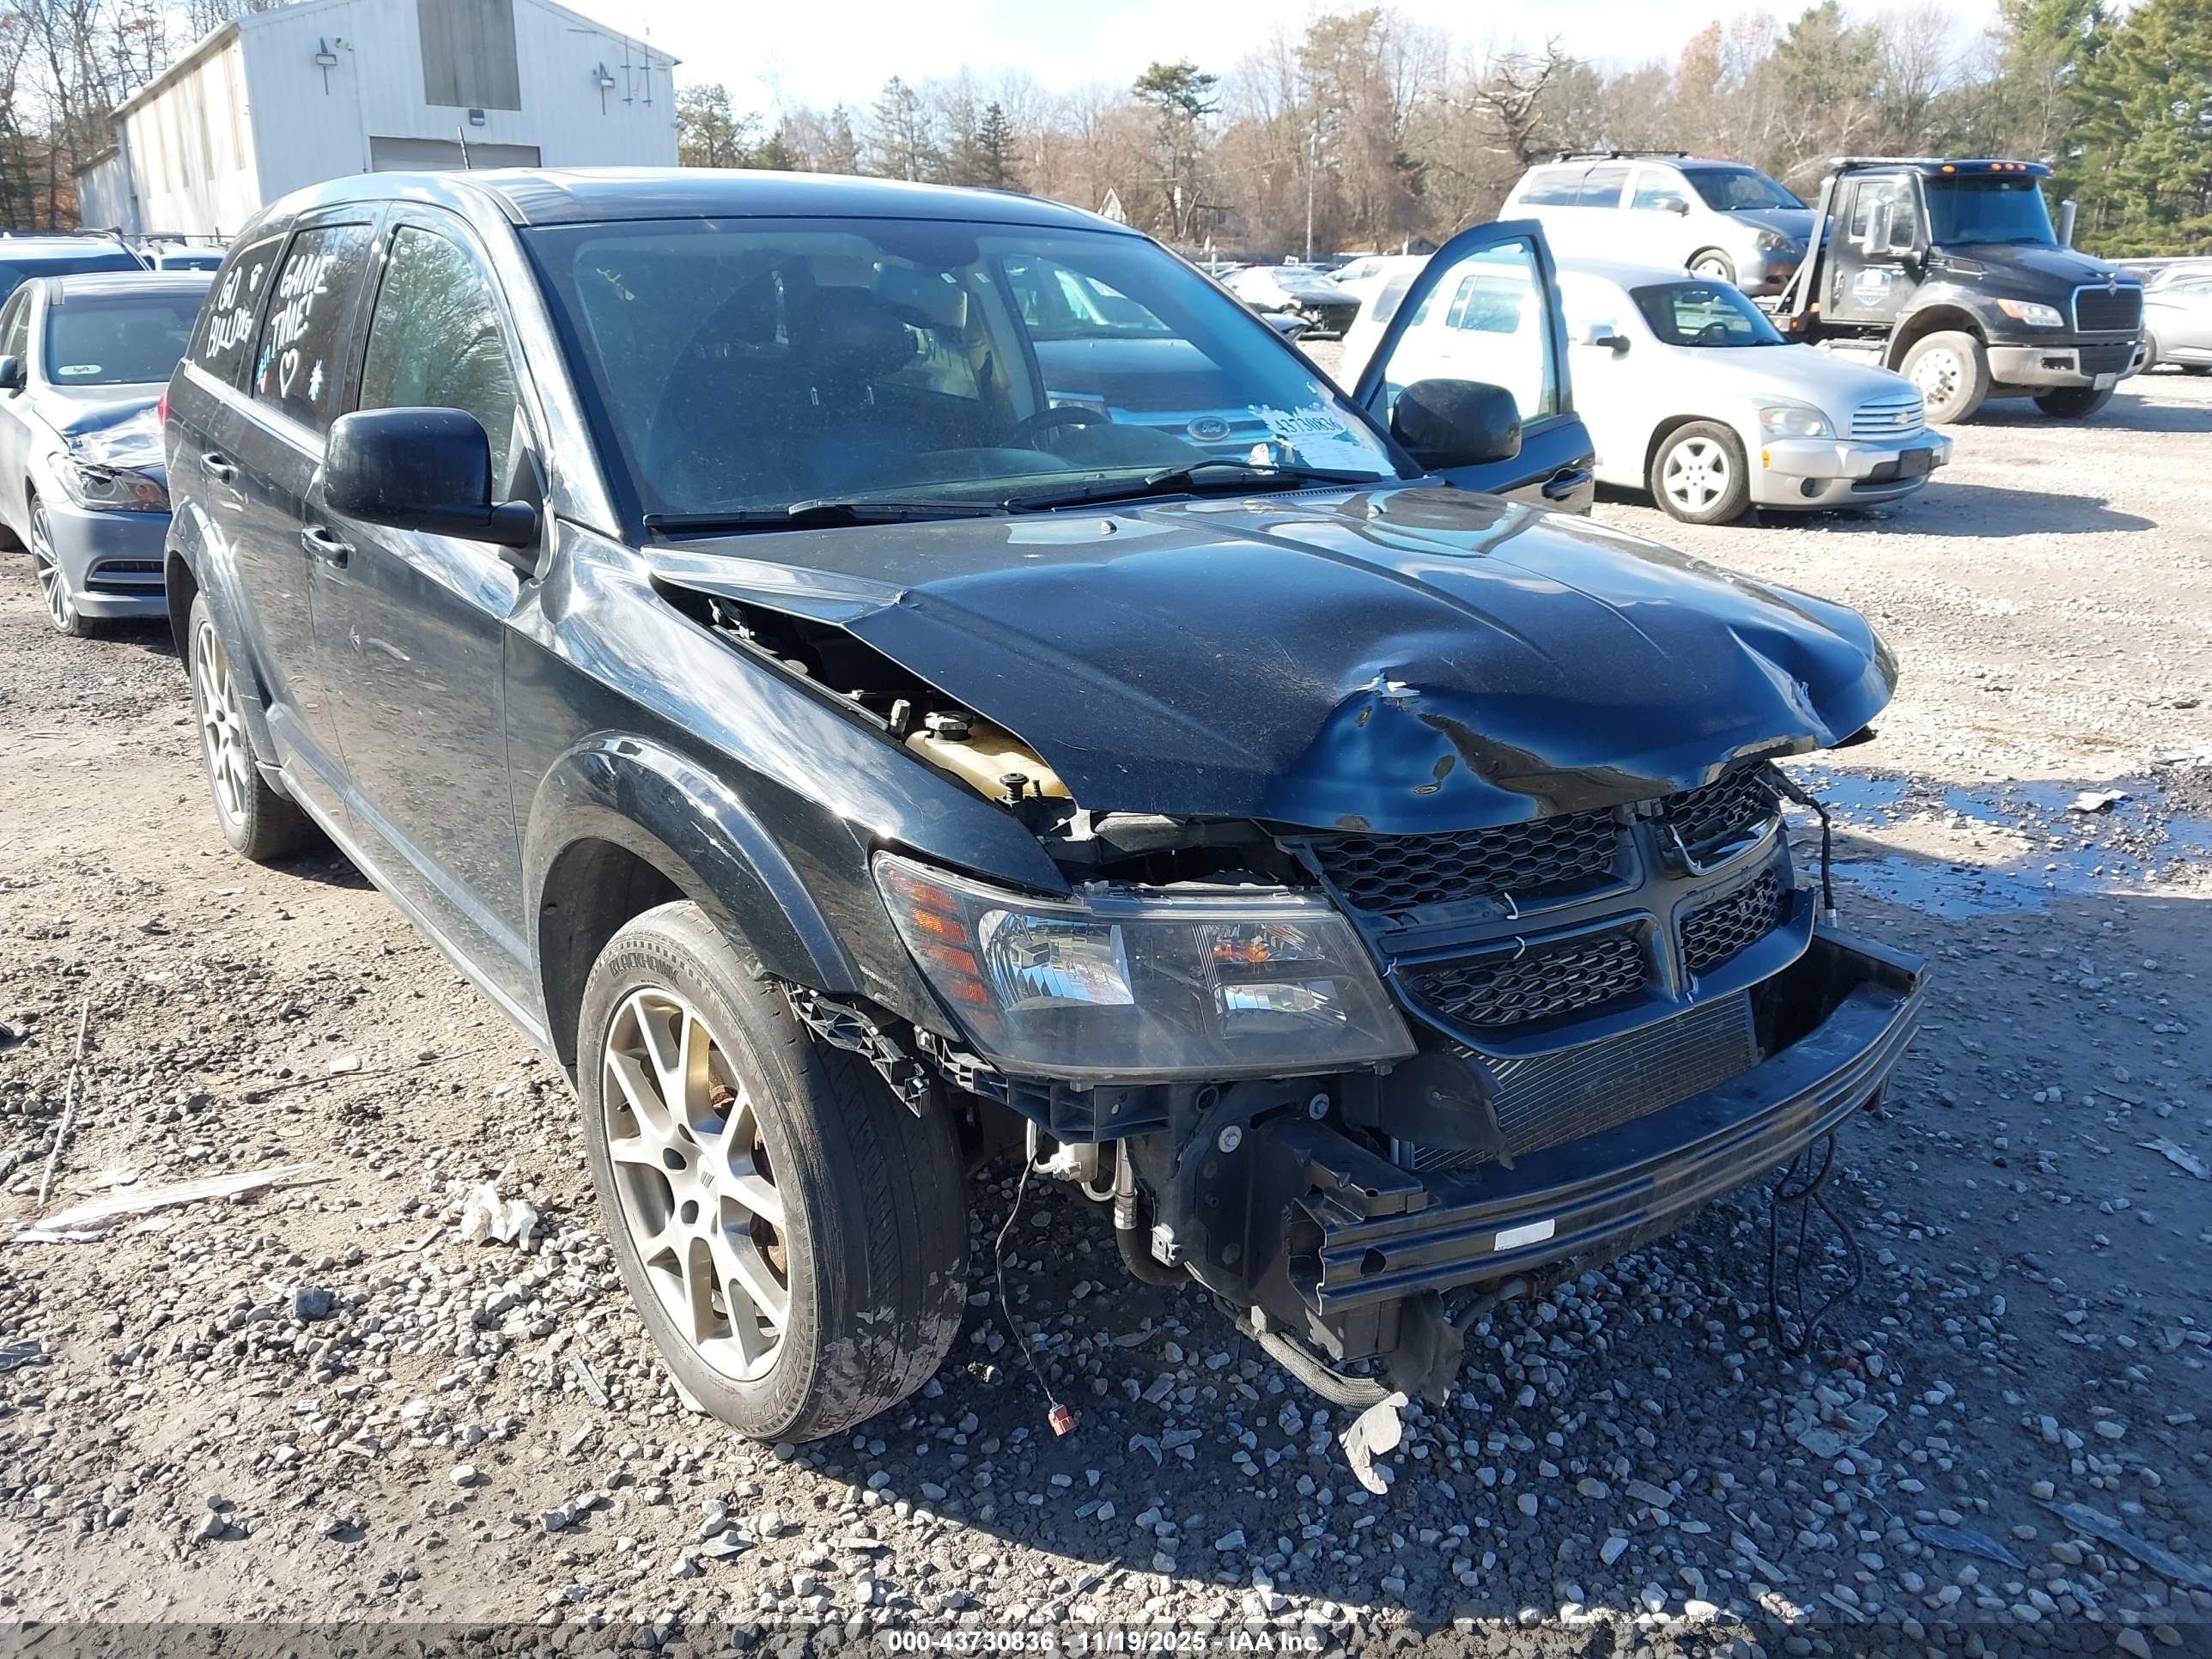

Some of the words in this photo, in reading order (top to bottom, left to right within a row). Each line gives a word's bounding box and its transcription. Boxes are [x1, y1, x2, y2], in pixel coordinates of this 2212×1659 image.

[218, 266, 242, 312] GO
[279, 254, 337, 300] GAME
[271, 292, 313, 359] TIME!
[1273, 418, 1345, 433] 43730836
[608, 952, 679, 987] BLACKHAWK
